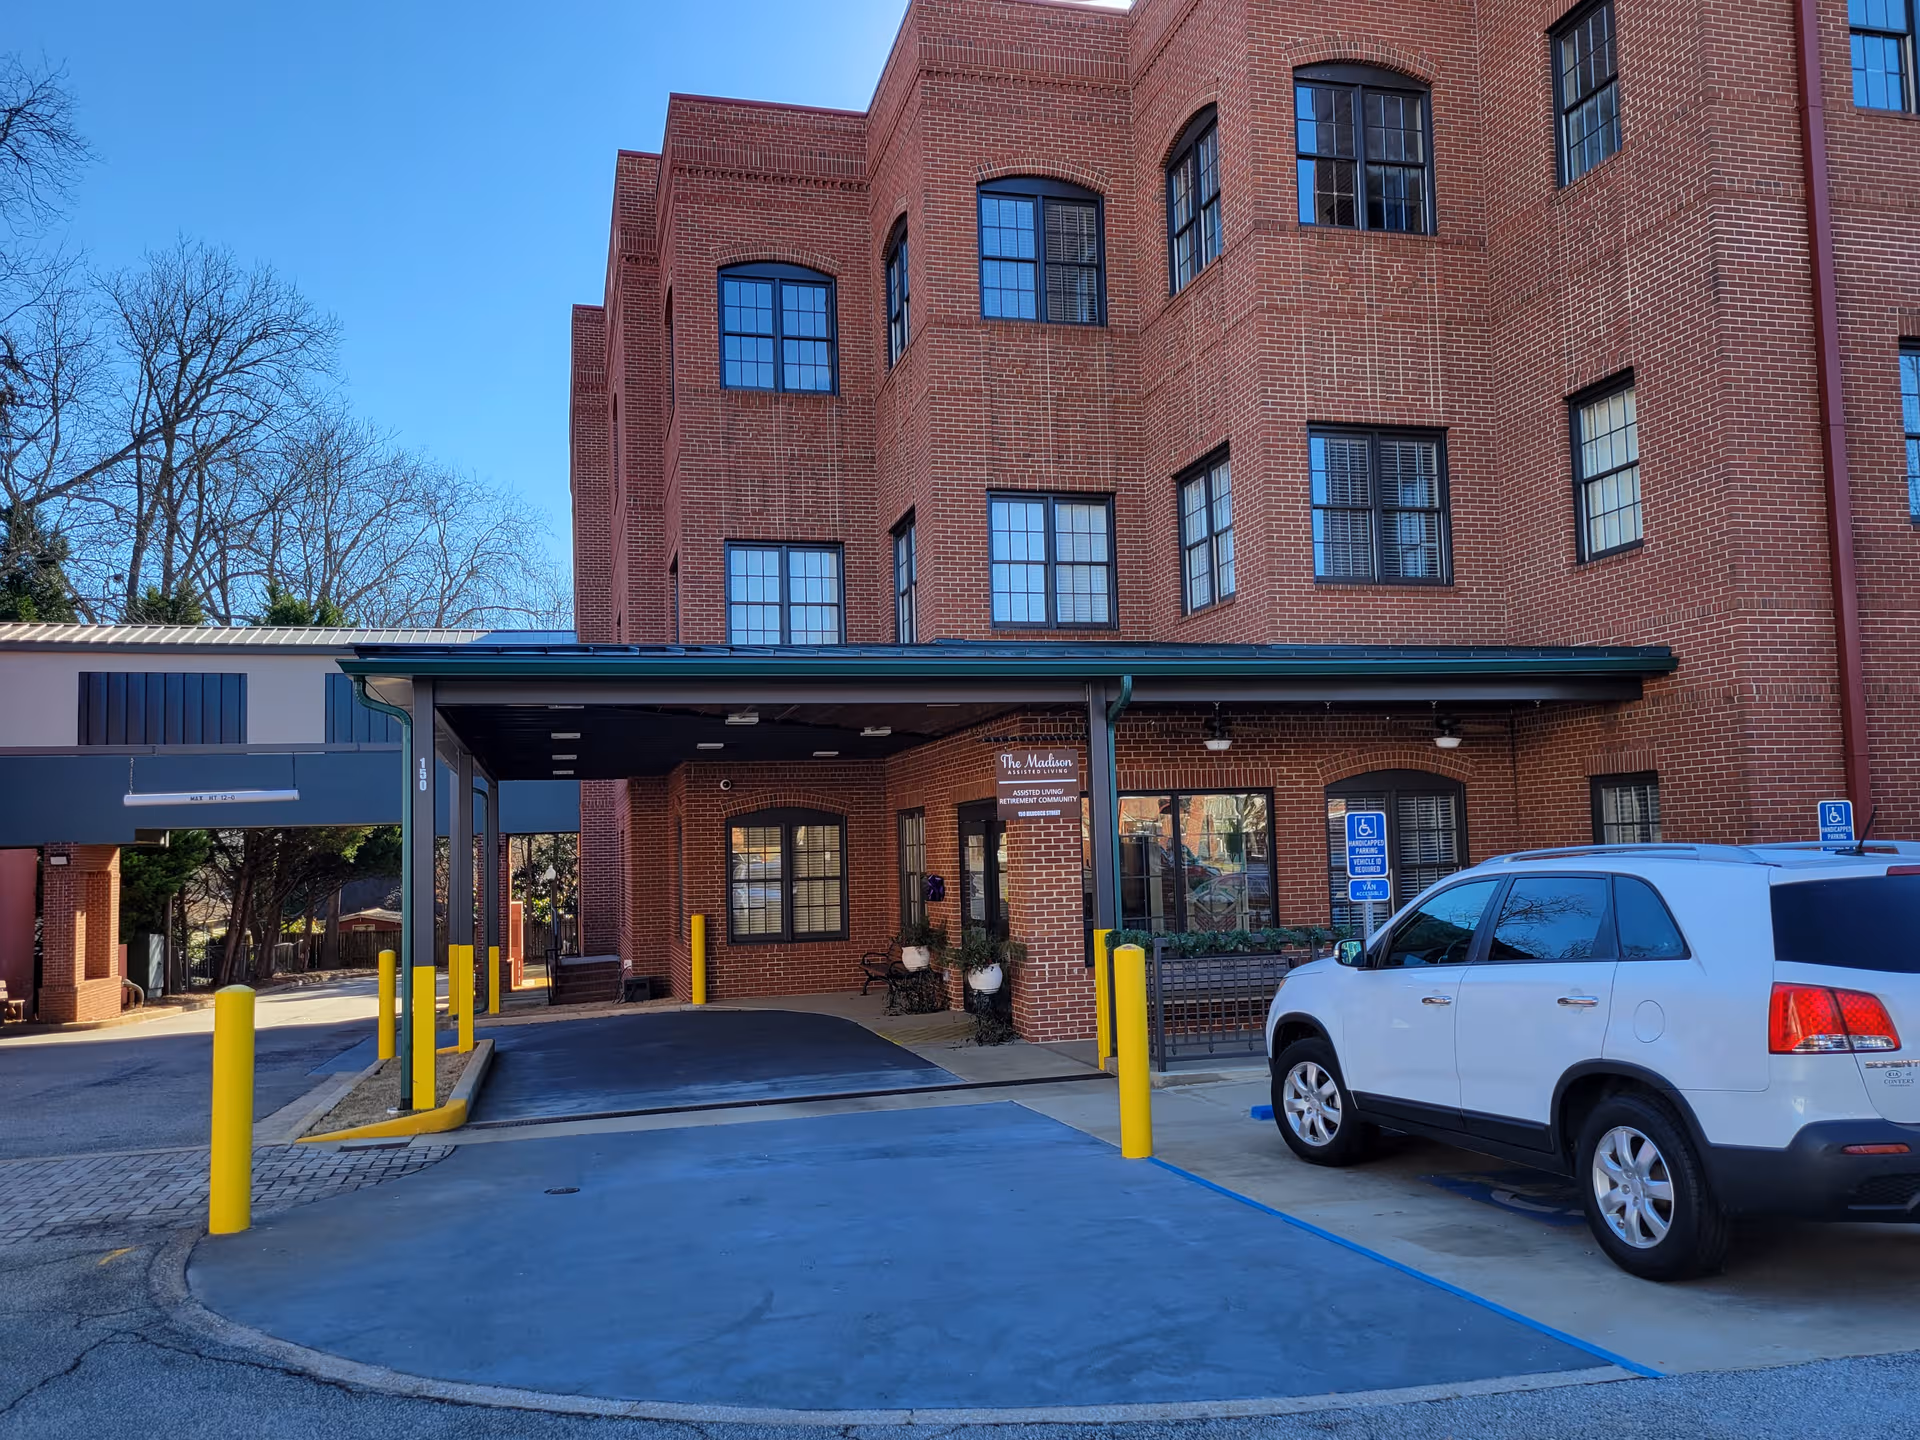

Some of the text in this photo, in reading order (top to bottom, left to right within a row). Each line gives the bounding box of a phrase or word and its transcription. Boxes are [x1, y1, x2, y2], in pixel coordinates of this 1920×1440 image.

[1001, 752, 1073, 769] The Madison
[419, 757, 427, 791] 150
[1038, 795, 1078, 803] COMMUNITY
[1348, 839, 1385, 847] HANDICAPPED
[1353, 857, 1382, 866] VEHICLE ID
[1354, 865, 1381, 873] REQUIRED
[1362, 883, 1377, 891] VAN
